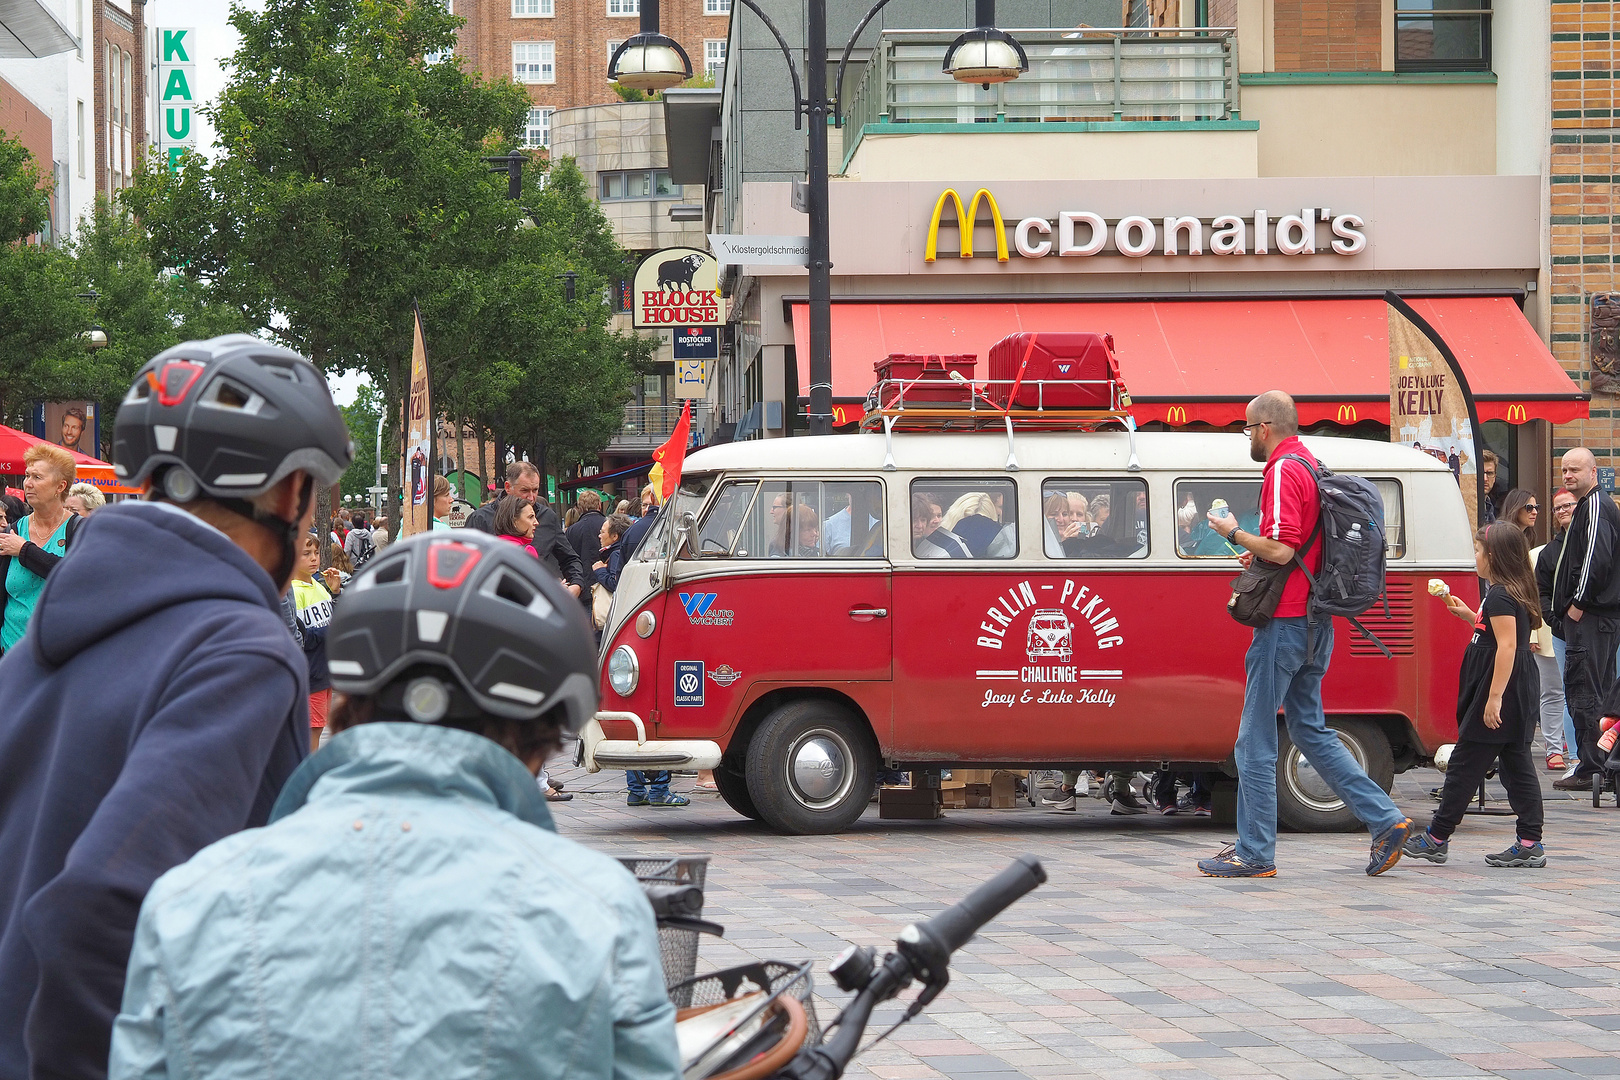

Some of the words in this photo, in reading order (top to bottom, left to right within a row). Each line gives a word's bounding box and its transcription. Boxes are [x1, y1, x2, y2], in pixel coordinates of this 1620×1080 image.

[924, 187, 1367, 262] McDonald's
[731, 245, 809, 256] Klostergoldschmiede
[642, 290, 718, 307] BLOCK
[642, 307, 718, 323] HOUSE
[678, 336, 712, 344] ROSTOCKER
[1398, 389, 1443, 415] KELLY
[689, 617, 734, 626] WICHERT
[705, 609, 735, 618] AUTO
[976, 580, 1037, 650] BERLIN
[1060, 579, 1124, 650] PEKING
[1021, 666, 1078, 683] CHALLENGE
[981, 689, 1016, 708] Joey
[1020, 689, 1034, 704] &
[1037, 689, 1073, 704] Luke
[1076, 689, 1116, 708] Kelly
